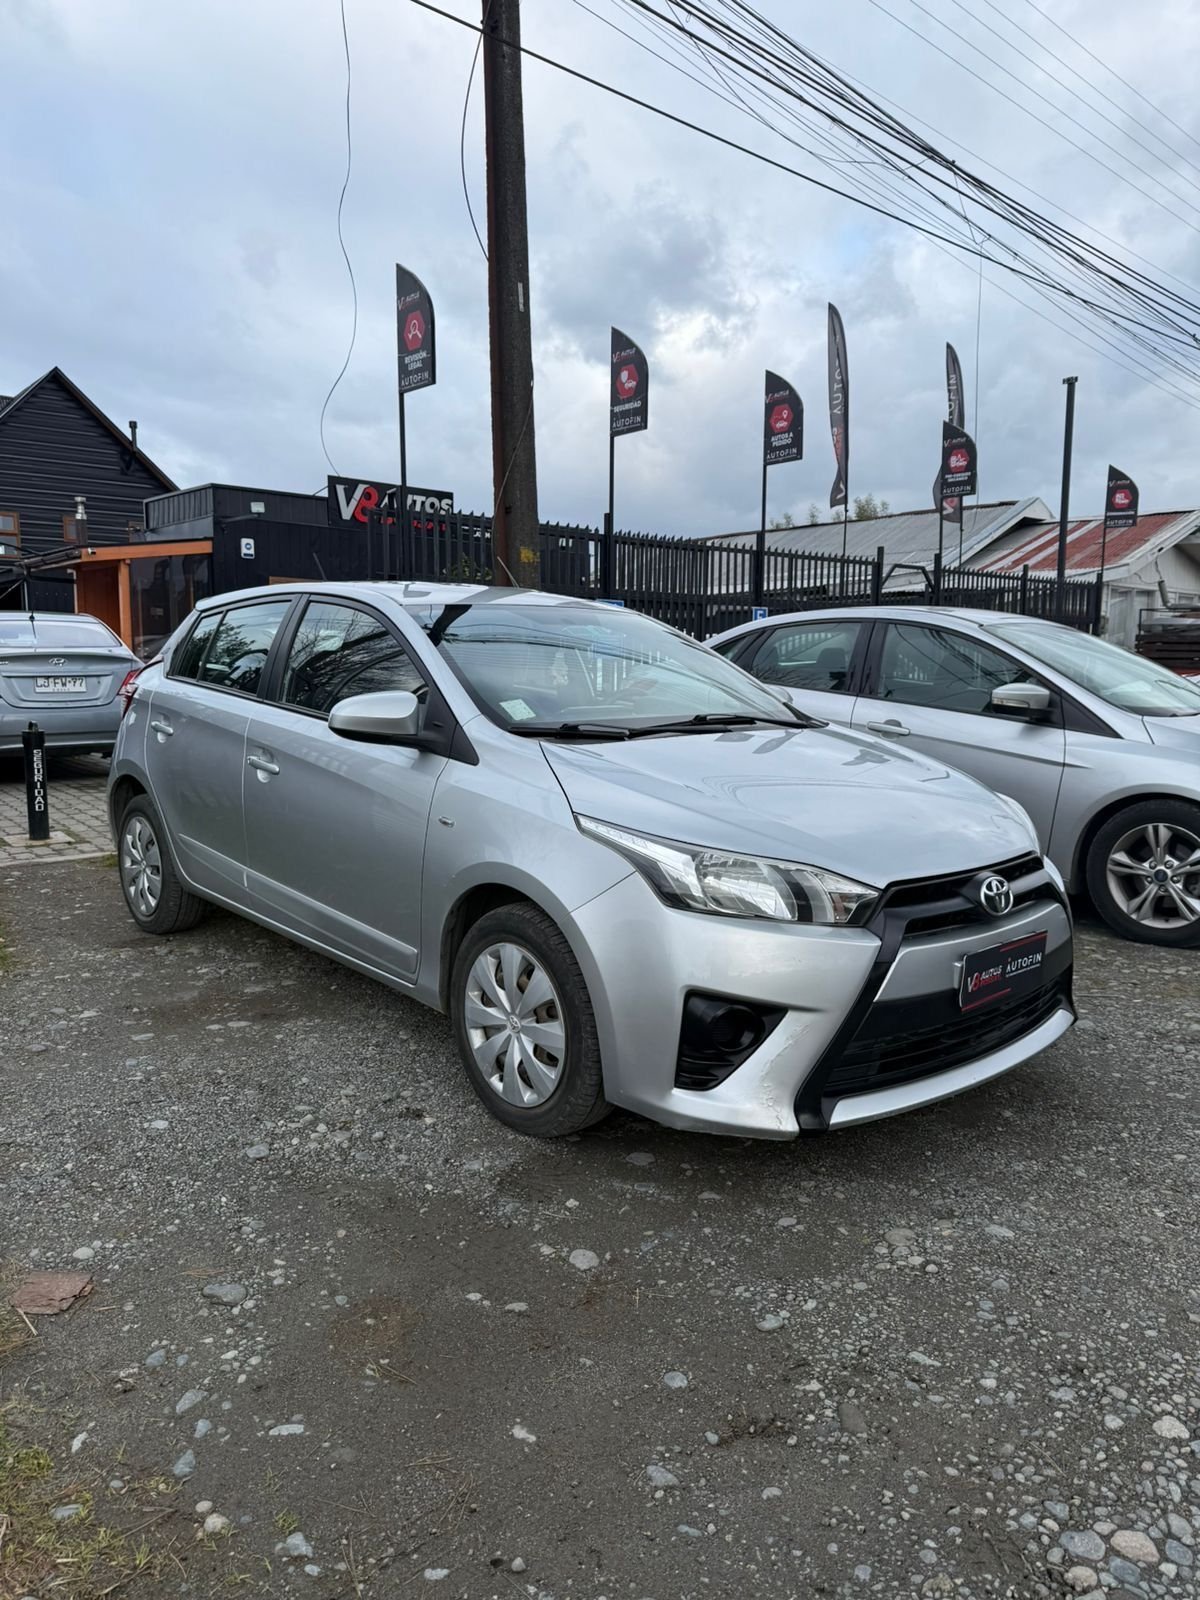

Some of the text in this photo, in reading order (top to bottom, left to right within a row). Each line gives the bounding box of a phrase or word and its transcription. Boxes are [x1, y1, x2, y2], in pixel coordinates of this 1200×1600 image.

[408, 360, 423, 371] LEGAL
[401, 371, 429, 387] AUTOFIN
[614, 400, 642, 414] SEGURIDAD
[612, 415, 641, 428] AUTOFIN
[771, 433, 789, 442] AUTOS
[772, 438, 792, 448] PEDIDO
[767, 447, 797, 460] AUTOFIN
[943, 485, 972, 494] AUTOFIN
[335, 483, 379, 523] V8
[33, 749, 45, 812] SEGURIDAD
[1006, 952, 1042, 974] AUTOFIN
[980, 965, 1003, 981] AUTOS
